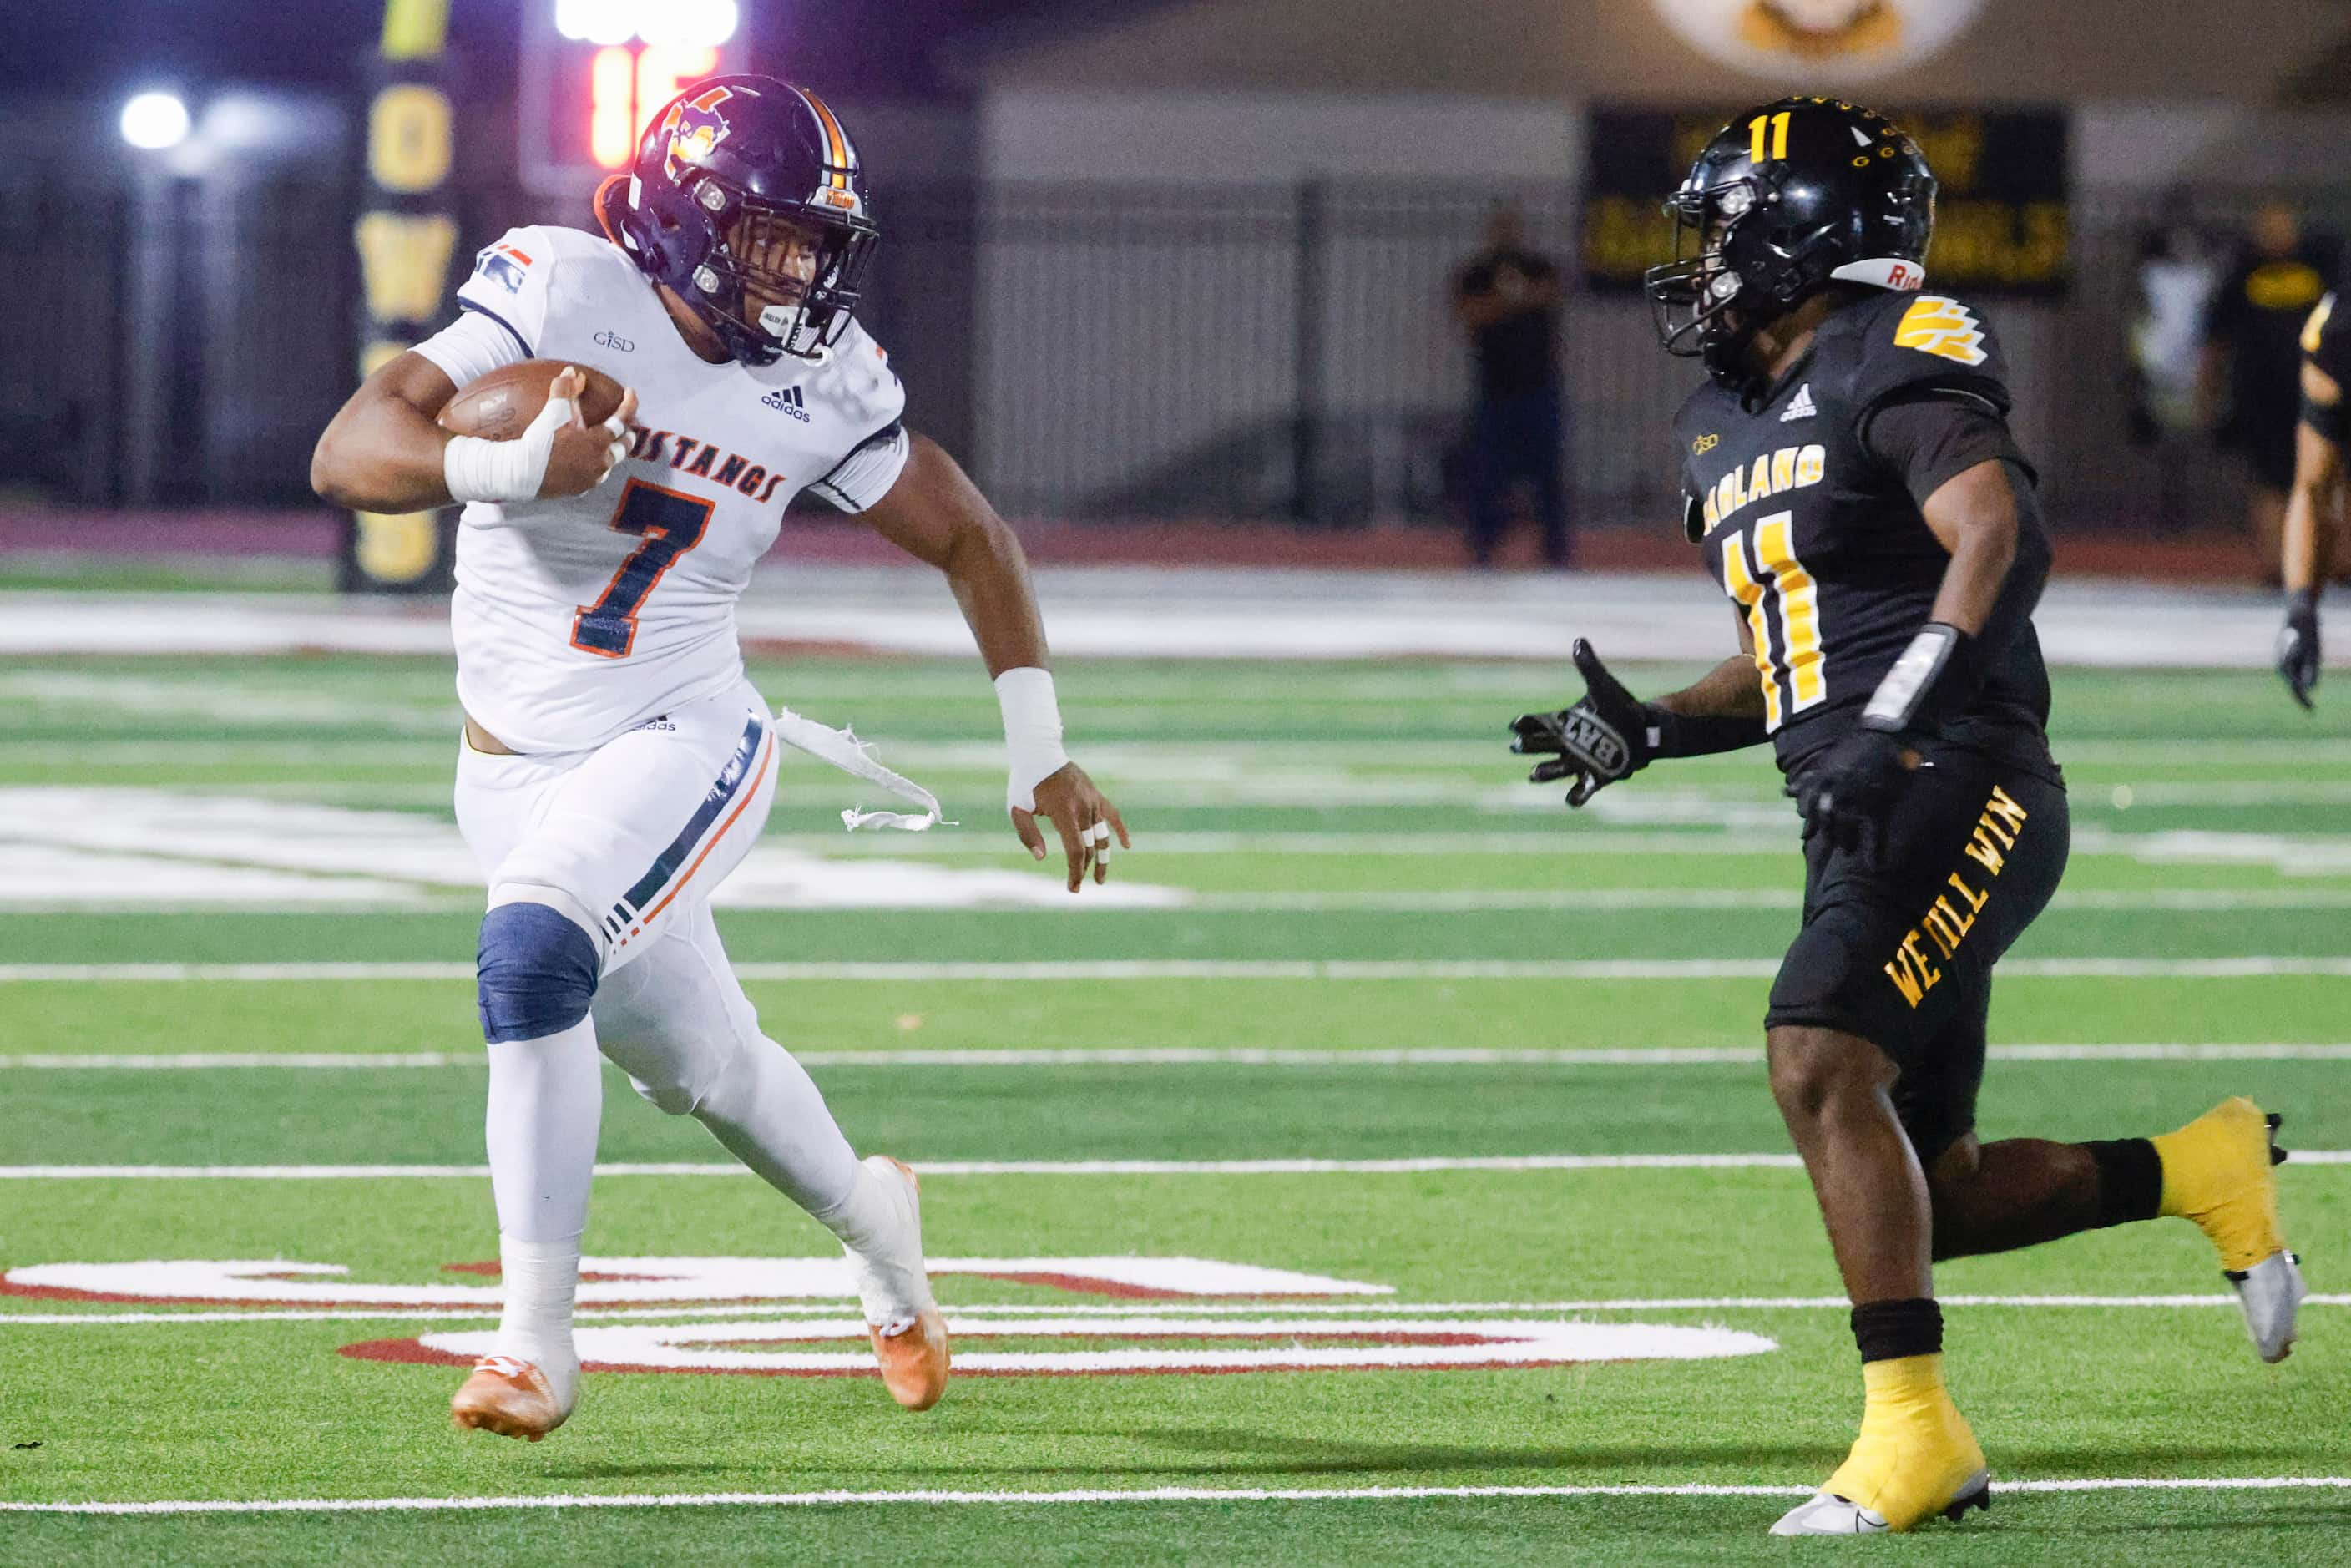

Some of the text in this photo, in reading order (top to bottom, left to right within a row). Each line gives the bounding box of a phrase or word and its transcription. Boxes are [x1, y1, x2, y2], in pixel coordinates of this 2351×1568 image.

[1748, 111, 1792, 164] 11
[761, 394, 811, 424] adidas
[569, 476, 716, 659] 7
[1722, 509, 1828, 736] 11
[1883, 928, 1942, 1009] WE
[1964, 783, 2029, 877] WIN
